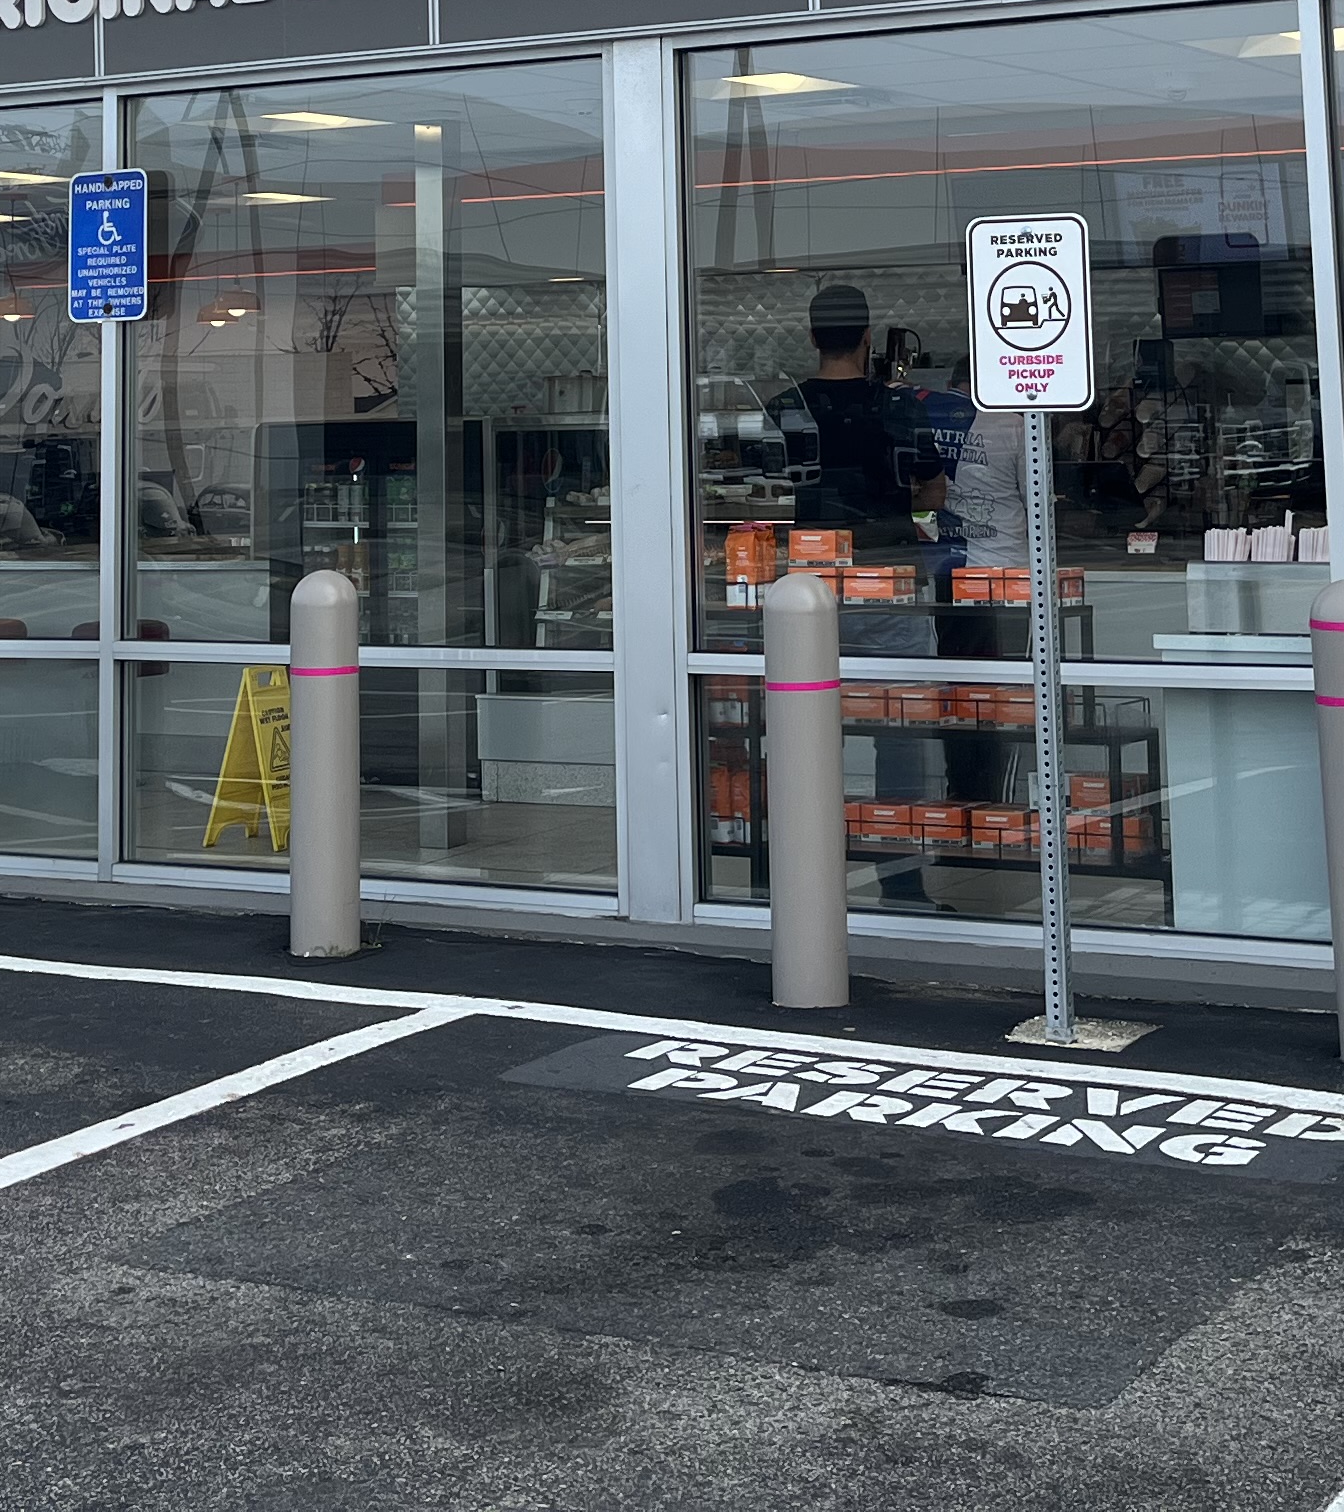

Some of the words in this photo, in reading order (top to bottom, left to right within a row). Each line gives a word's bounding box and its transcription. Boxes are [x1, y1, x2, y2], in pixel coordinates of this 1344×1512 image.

[74, 179, 143, 194] HANDIAPPED
[85, 198, 130, 211] PARKING
[990, 232, 1063, 246] RESERVED
[77, 246, 109, 256] SPECIAL
[112, 244, 136, 254] PLATE
[996, 246, 1058, 258] PARKING
[86, 255, 127, 266] REQUIRED
[77, 266, 137, 277] UNAUTHORIZED
[87, 277, 127, 287] VEHICLES
[71, 289, 87, 298] MAY
[91, 288, 102, 297] BE
[107, 287, 144, 297] REMOVED
[73, 299, 83, 308] AT
[87, 298, 102, 308] THE
[88, 307, 126, 317] EXPNSE
[999, 354, 1064, 366] CURBSIDE
[1008, 368, 1055, 380] PICKUP
[1015, 382, 1050, 393] ONLY
[932, 428, 985, 448] ATRIA
[627, 1067, 1267, 1166] PARKING
